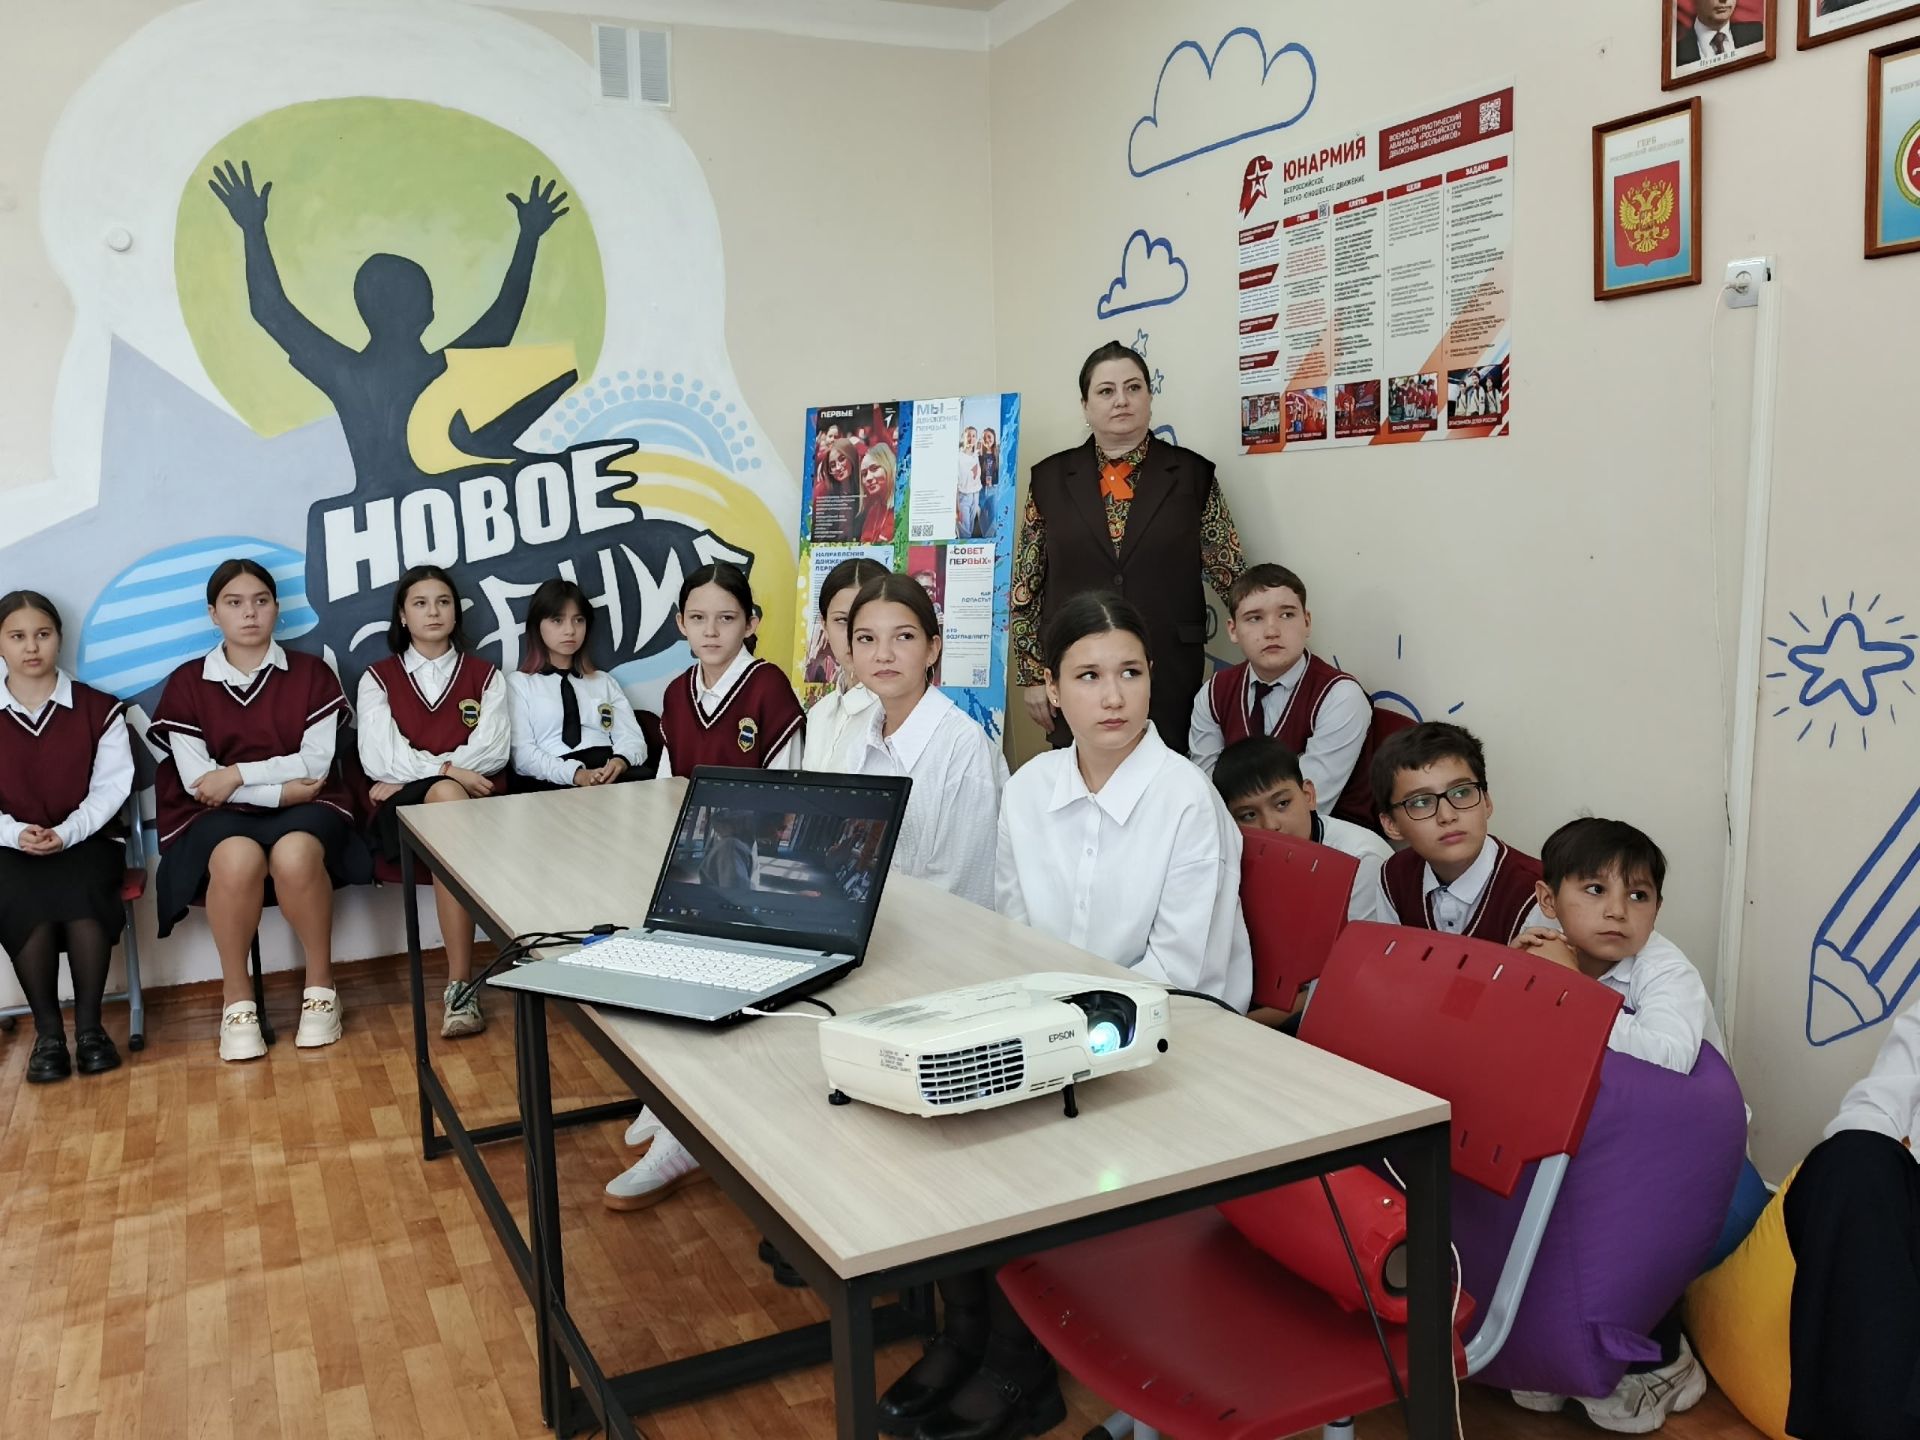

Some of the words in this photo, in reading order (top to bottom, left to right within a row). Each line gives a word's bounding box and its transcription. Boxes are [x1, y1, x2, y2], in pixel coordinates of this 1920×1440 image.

[1388, 111, 1462, 142] ВОЕННО-ПАТРИОТИЧЕСКИЙ
[1637, 136, 1657, 149] ГЕРБ
[1283, 136, 1366, 183] ЮНАРМИЯ
[1465, 162, 1490, 176] ЗАДАЧИ
[1283, 176, 1325, 195] ВСЕРОССИЙСКОЕ
[1335, 174, 1365, 191] ДВИЖЕНИЕ
[820, 410, 854, 419] ПЕРВЫЕ
[916, 402, 944, 416] МЫ
[324, 443, 634, 602] НОВОЕ
[1048, 1029, 1075, 1043] EPSON
